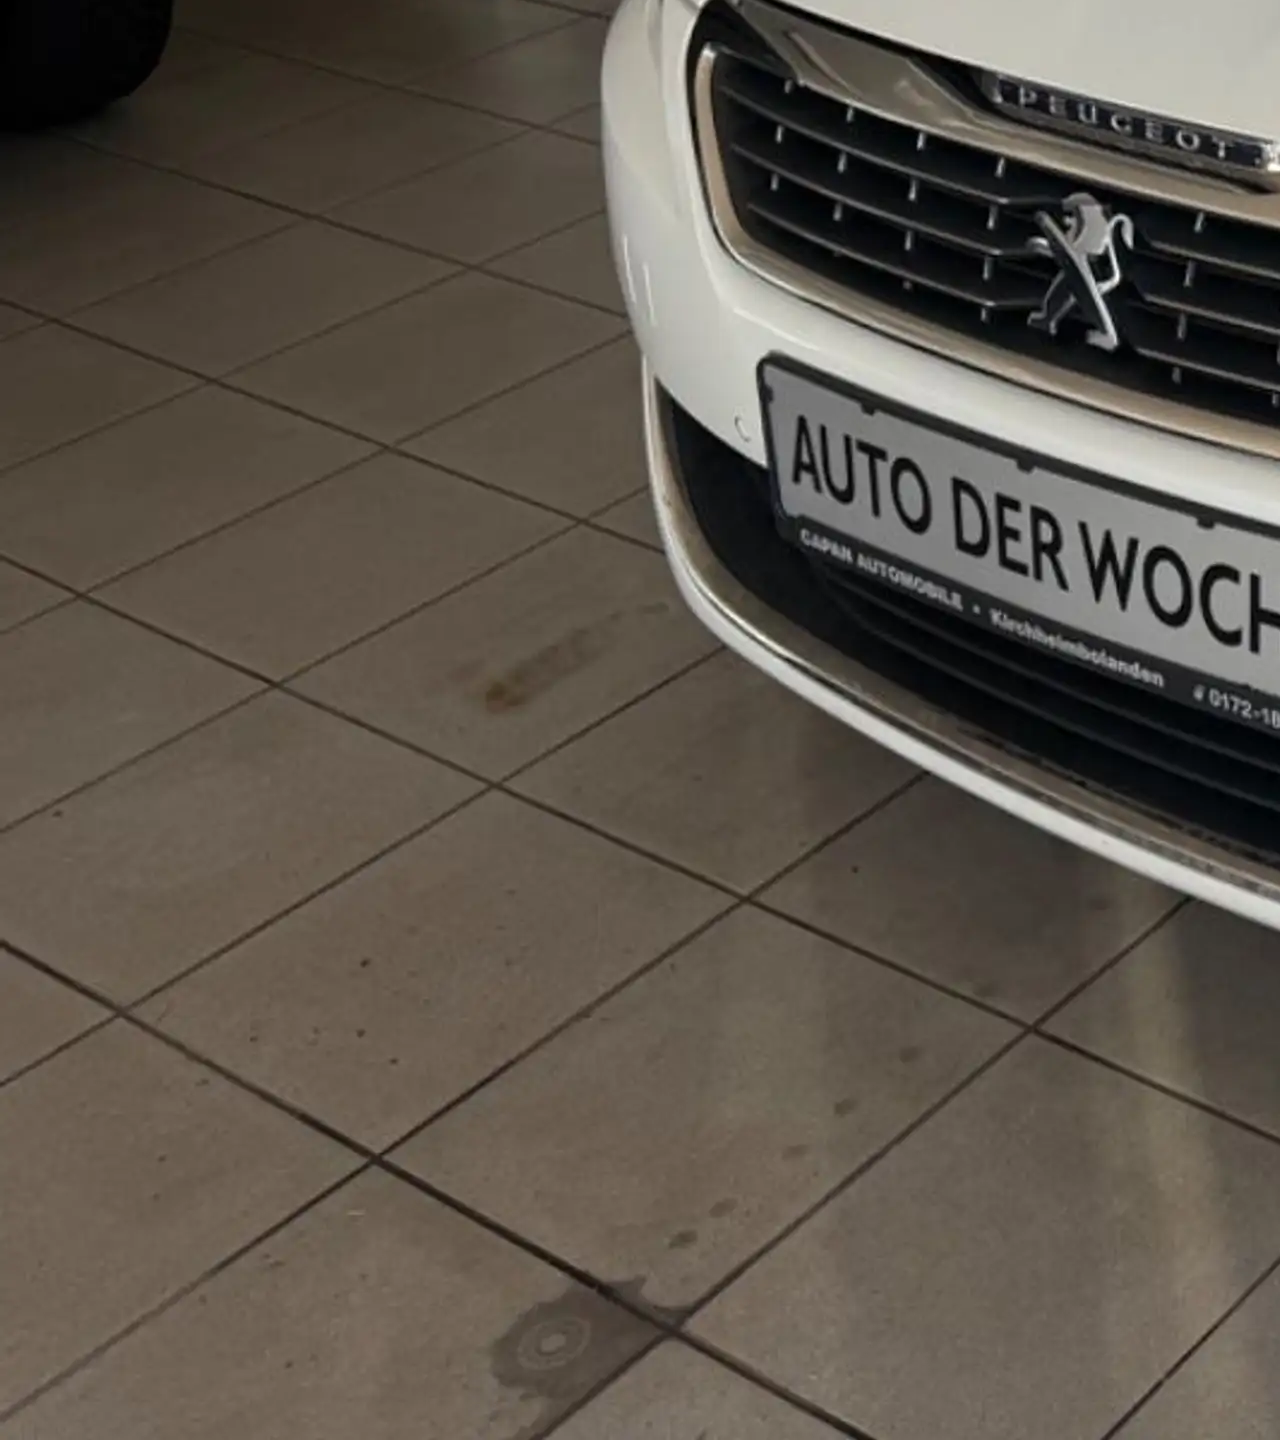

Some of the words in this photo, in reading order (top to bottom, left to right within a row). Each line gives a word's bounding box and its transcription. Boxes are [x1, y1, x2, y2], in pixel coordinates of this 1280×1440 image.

[1018, 83, 1234, 159] PEUGEOT
[791, 414, 932, 535] AUTO
[952, 476, 1069, 593] DER
[800, 528, 854, 564] CAPAN
[856, 552, 964, 611] AUTOMOBILE
